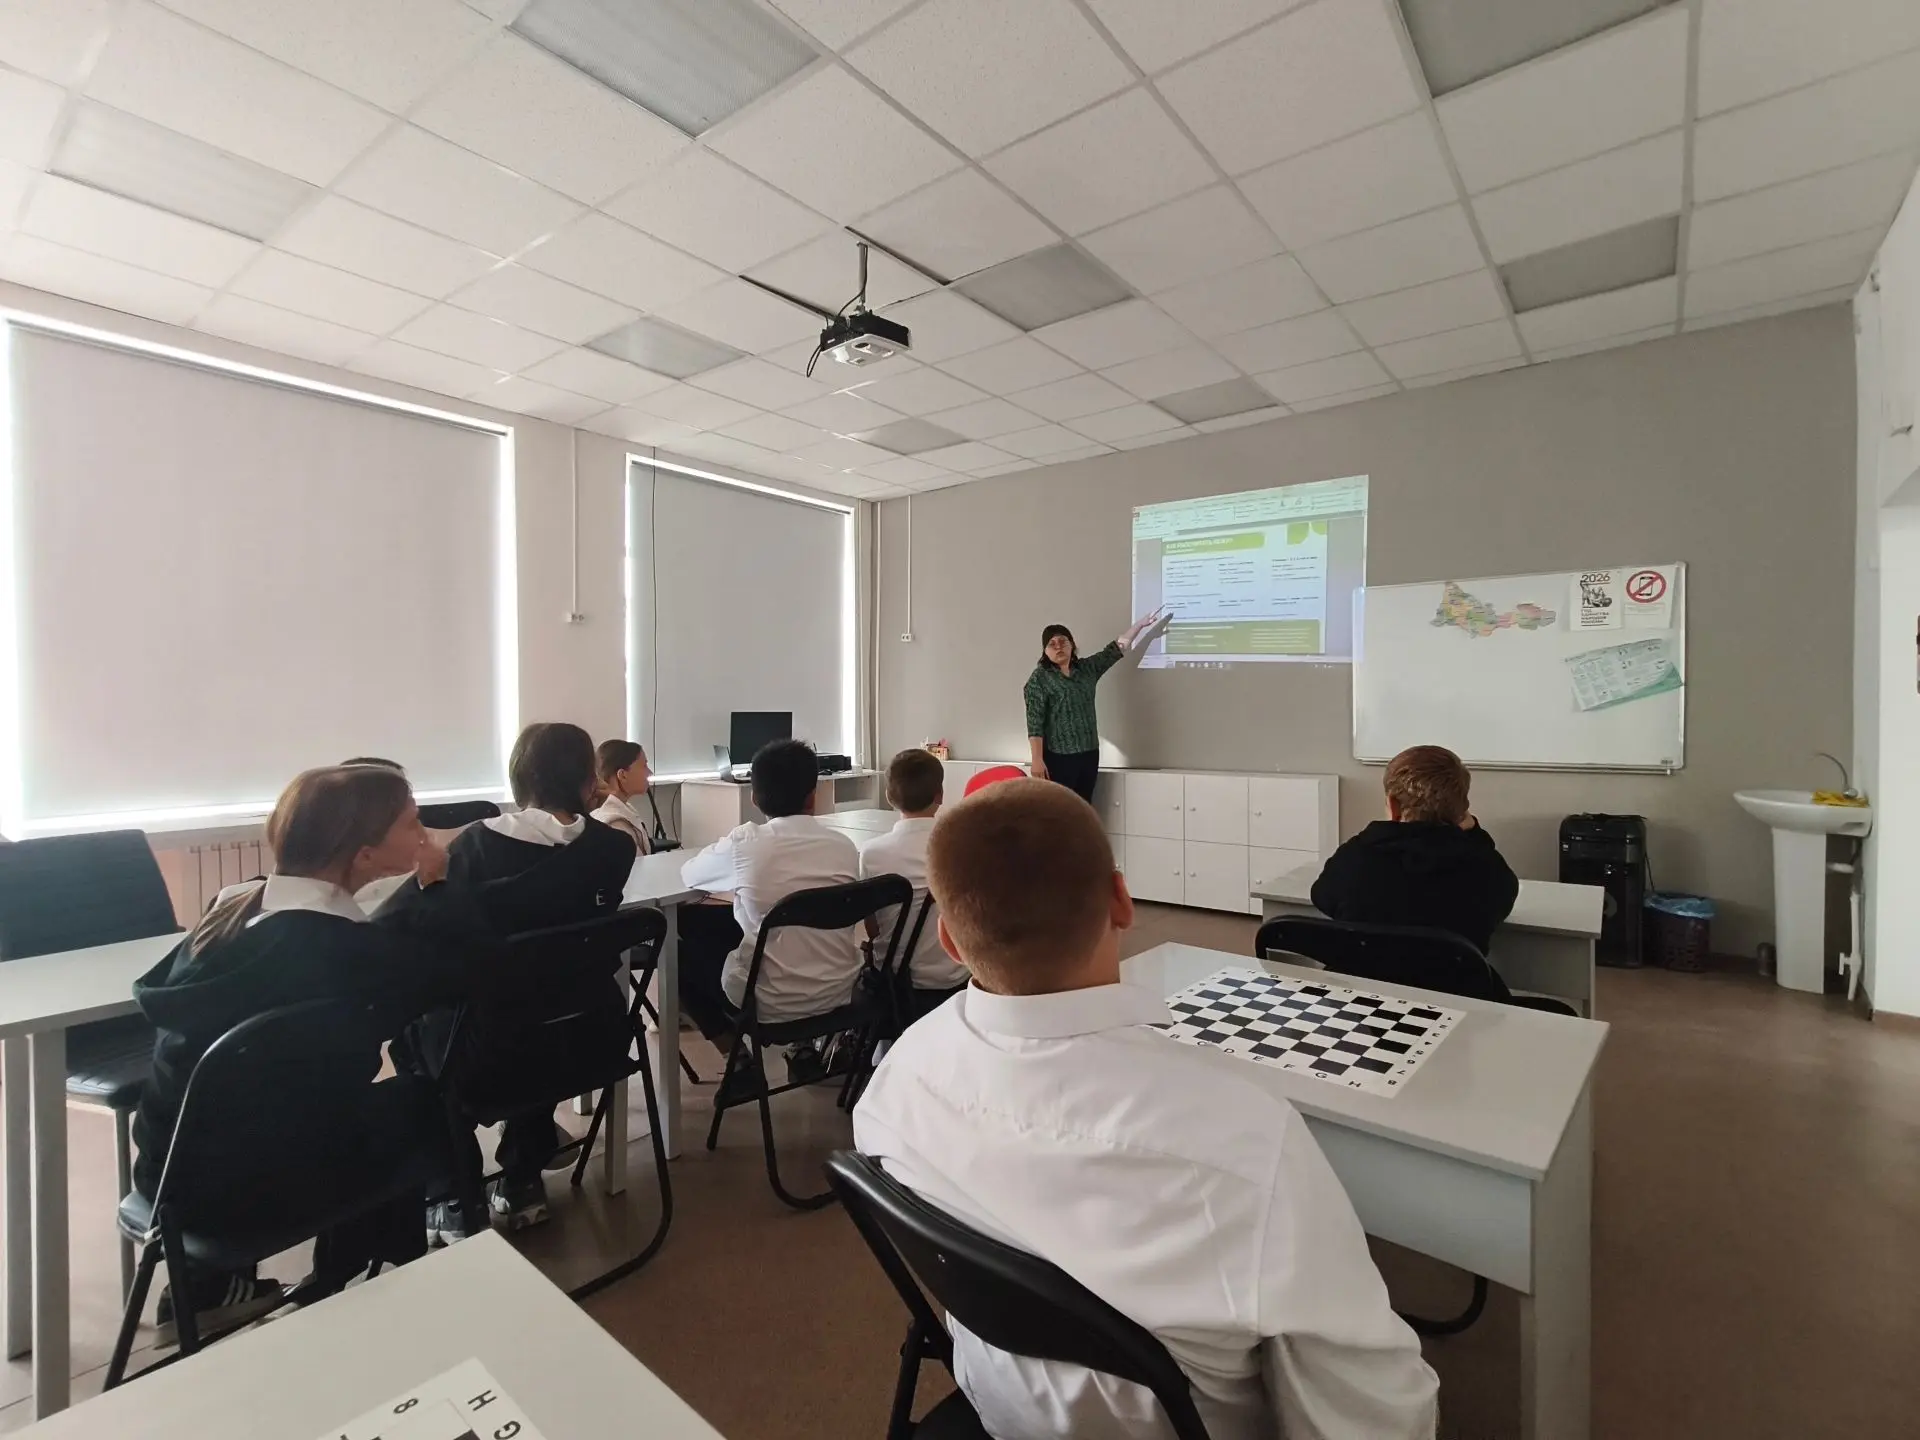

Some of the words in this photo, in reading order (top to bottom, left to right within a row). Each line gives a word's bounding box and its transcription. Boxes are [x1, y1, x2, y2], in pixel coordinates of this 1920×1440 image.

[1581, 573, 1610, 583] 2026
[393, 1398, 419, 1414] 8
[468, 1390, 497, 1411] H
[494, 1420, 521, 1440] G
